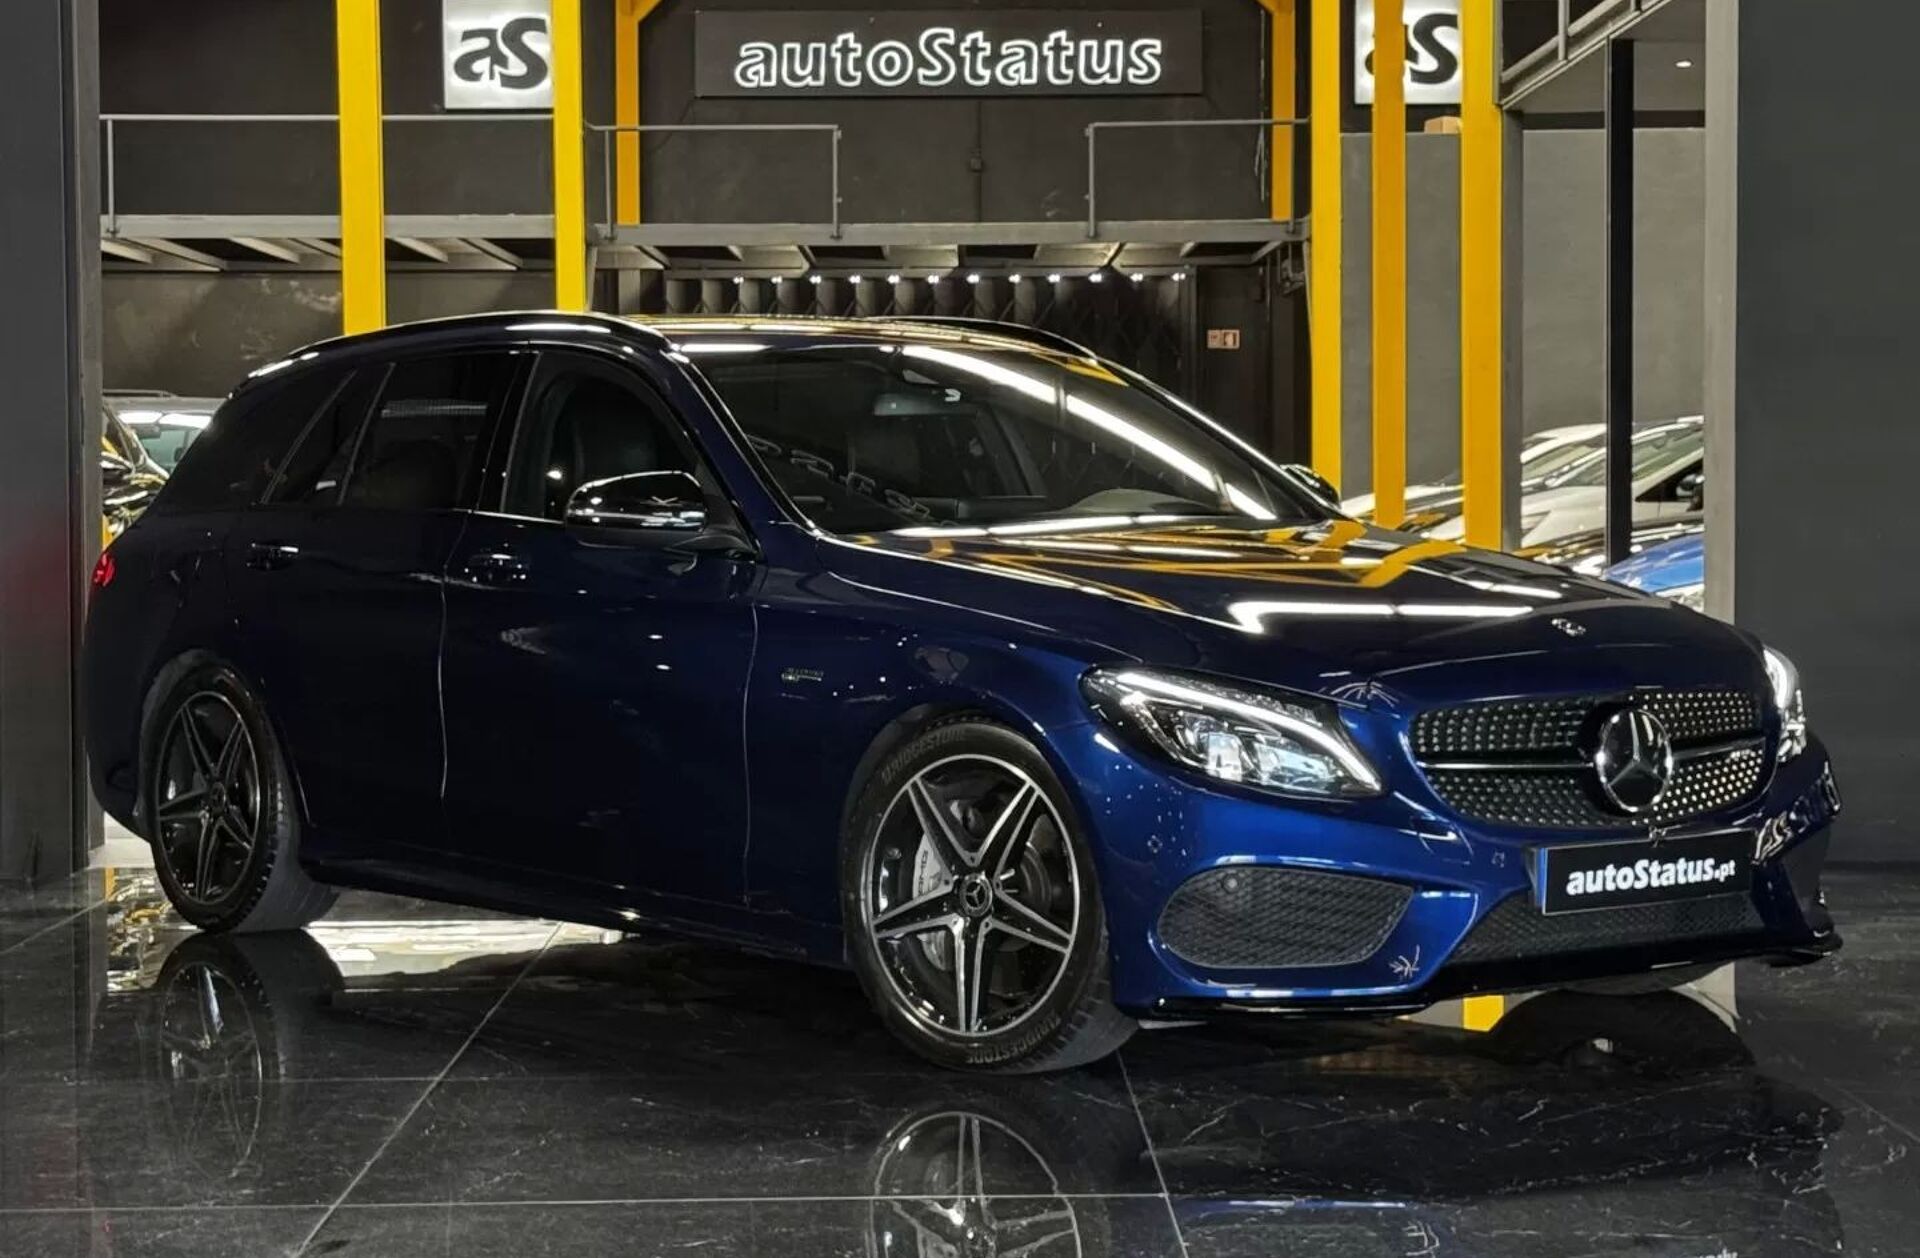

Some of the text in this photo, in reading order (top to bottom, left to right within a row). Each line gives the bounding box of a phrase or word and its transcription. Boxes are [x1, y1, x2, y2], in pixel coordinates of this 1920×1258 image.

[453, 17, 548, 89] aS
[734, 27, 1162, 87] autoStatus
[1365, 13, 1458, 85] S
[1565, 857, 1736, 896] autoStatus.pt
